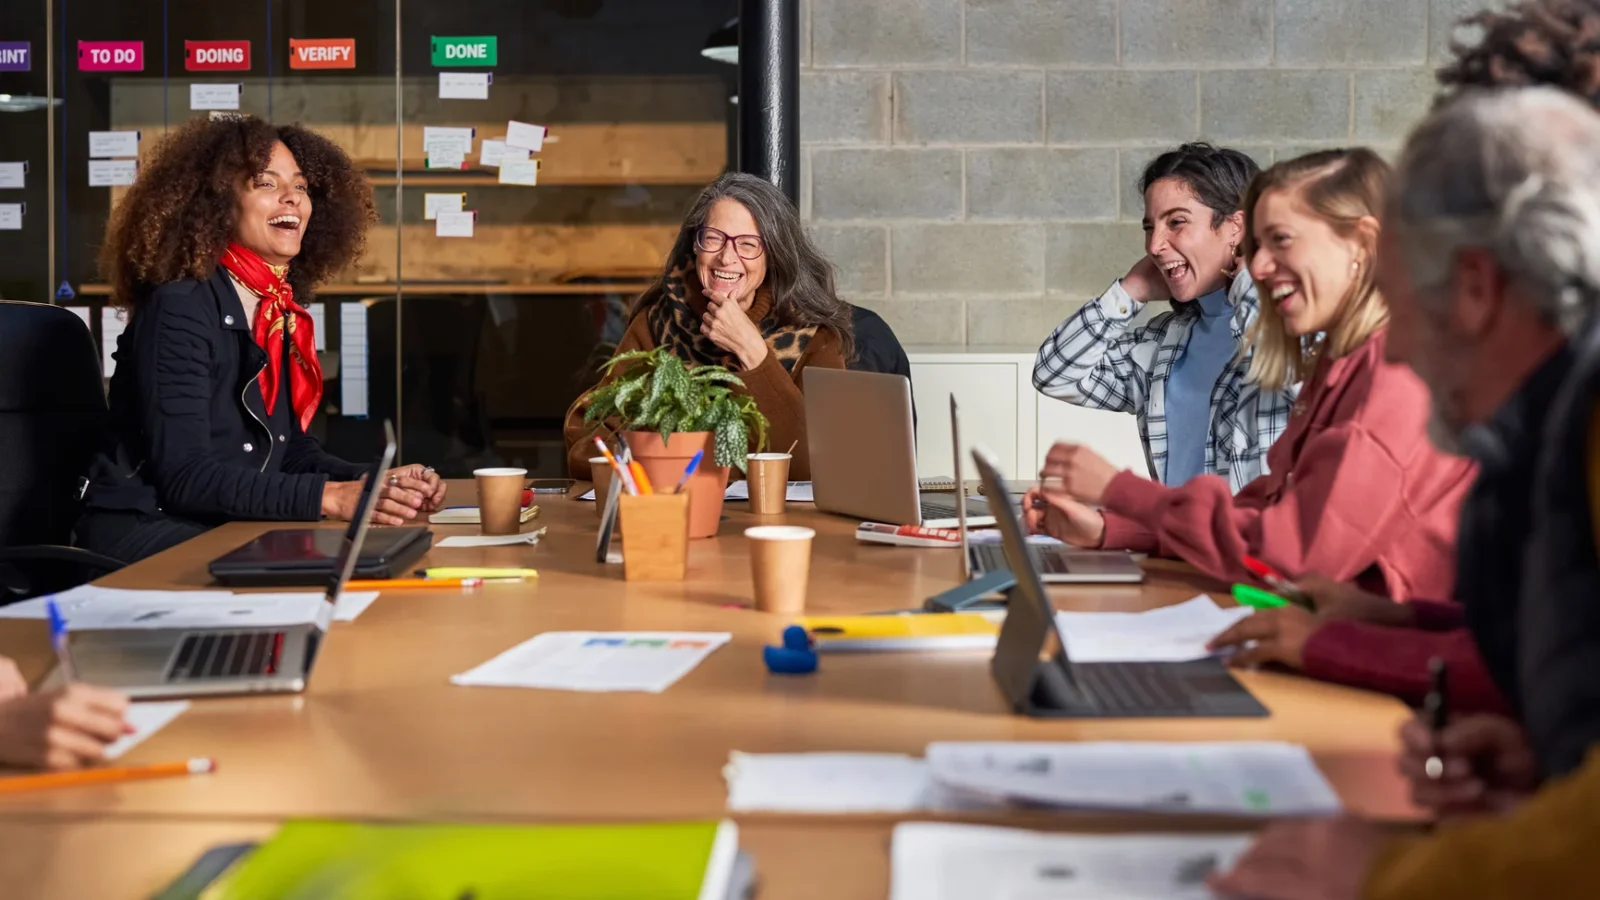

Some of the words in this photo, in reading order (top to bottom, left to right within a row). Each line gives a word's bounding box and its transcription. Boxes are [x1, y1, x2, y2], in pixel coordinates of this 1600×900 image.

[0, 49, 27, 64] INT
[91, 49, 111, 64] TO
[114, 49, 136, 64] DO
[196, 47, 244, 64] DOING
[298, 46, 351, 62] VERIFY
[445, 44, 487, 60] DONE
